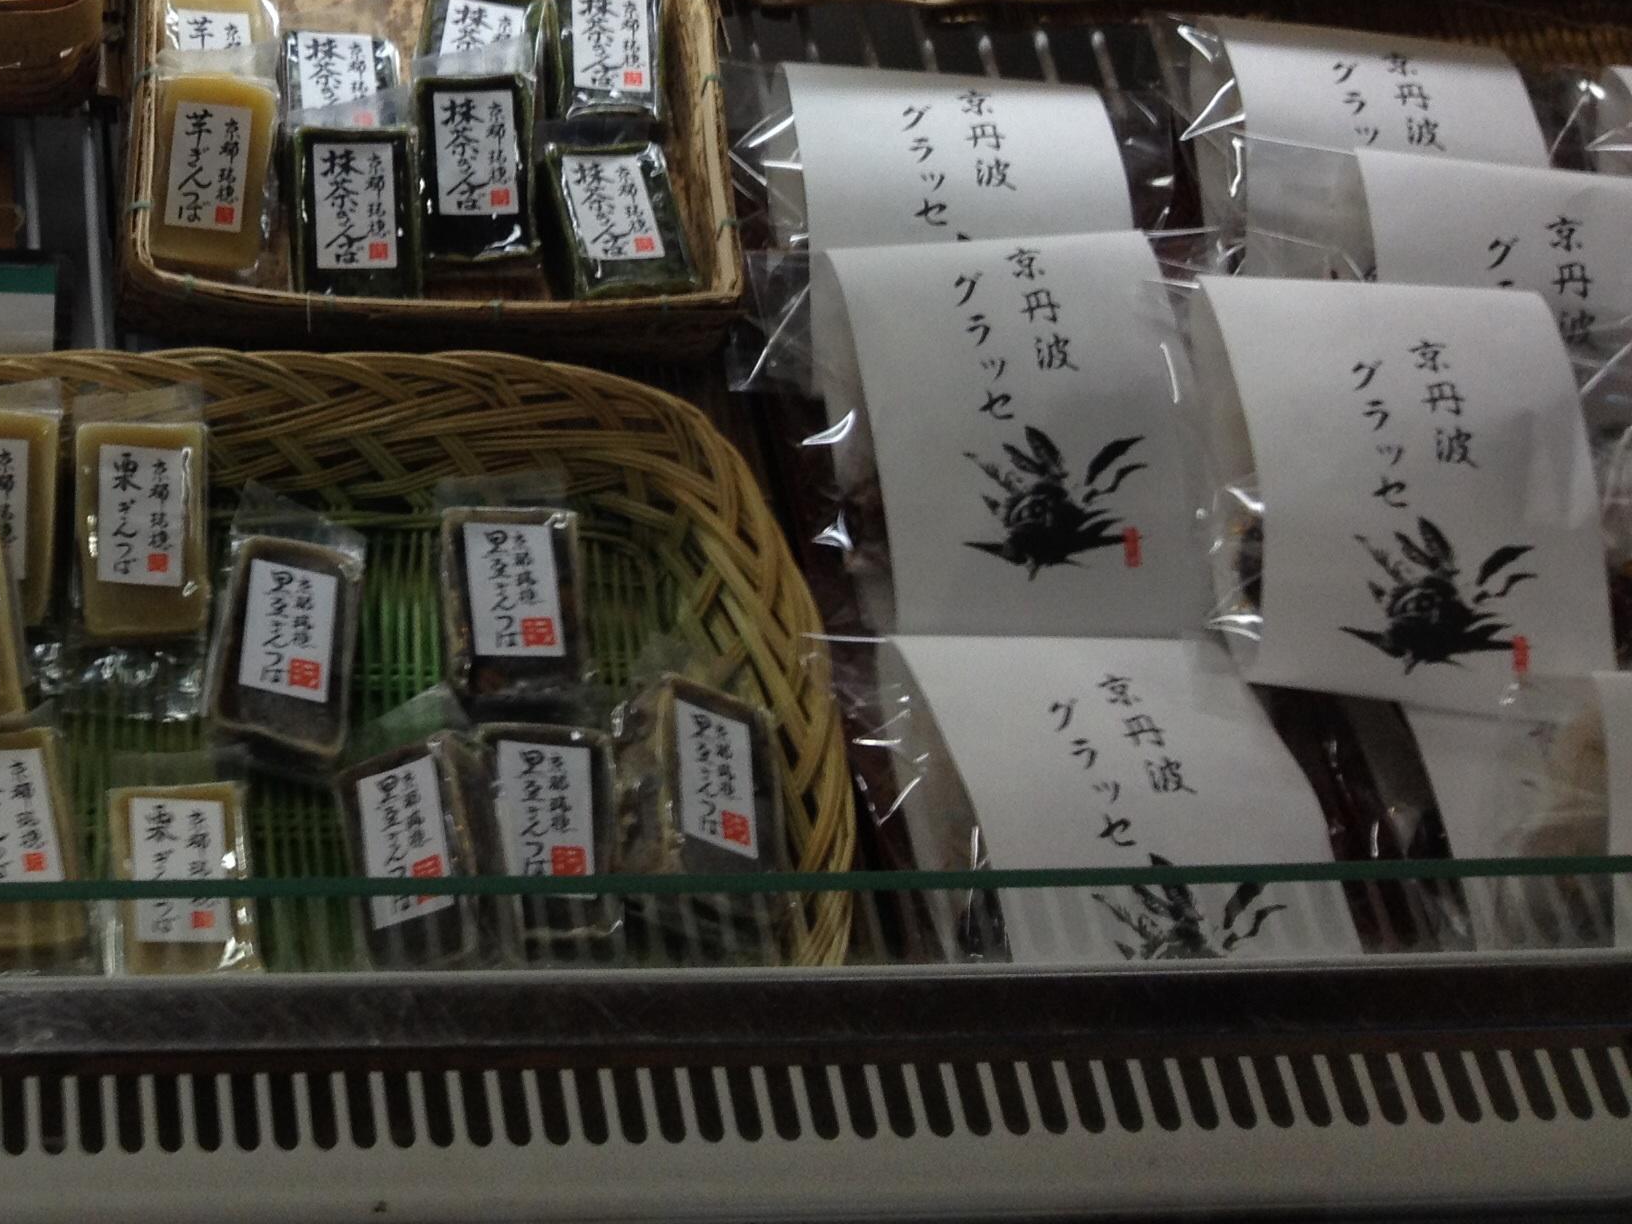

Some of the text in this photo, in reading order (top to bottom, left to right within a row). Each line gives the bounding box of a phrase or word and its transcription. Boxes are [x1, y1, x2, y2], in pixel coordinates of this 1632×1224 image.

[900, 102, 950, 229] グラッセ
[957, 89, 1019, 193] 京丹波
[1381, 51, 1448, 154] 京丹波
[954, 270, 1017, 422] グラッセ
[1005, 246, 1081, 376] 京丹波
[1350, 357, 1410, 510] グラッセ
[1408, 338, 1480, 471] 京丹波
[1047, 697, 1137, 850] グラッセ
[1096, 672, 1200, 798] 京丹波
